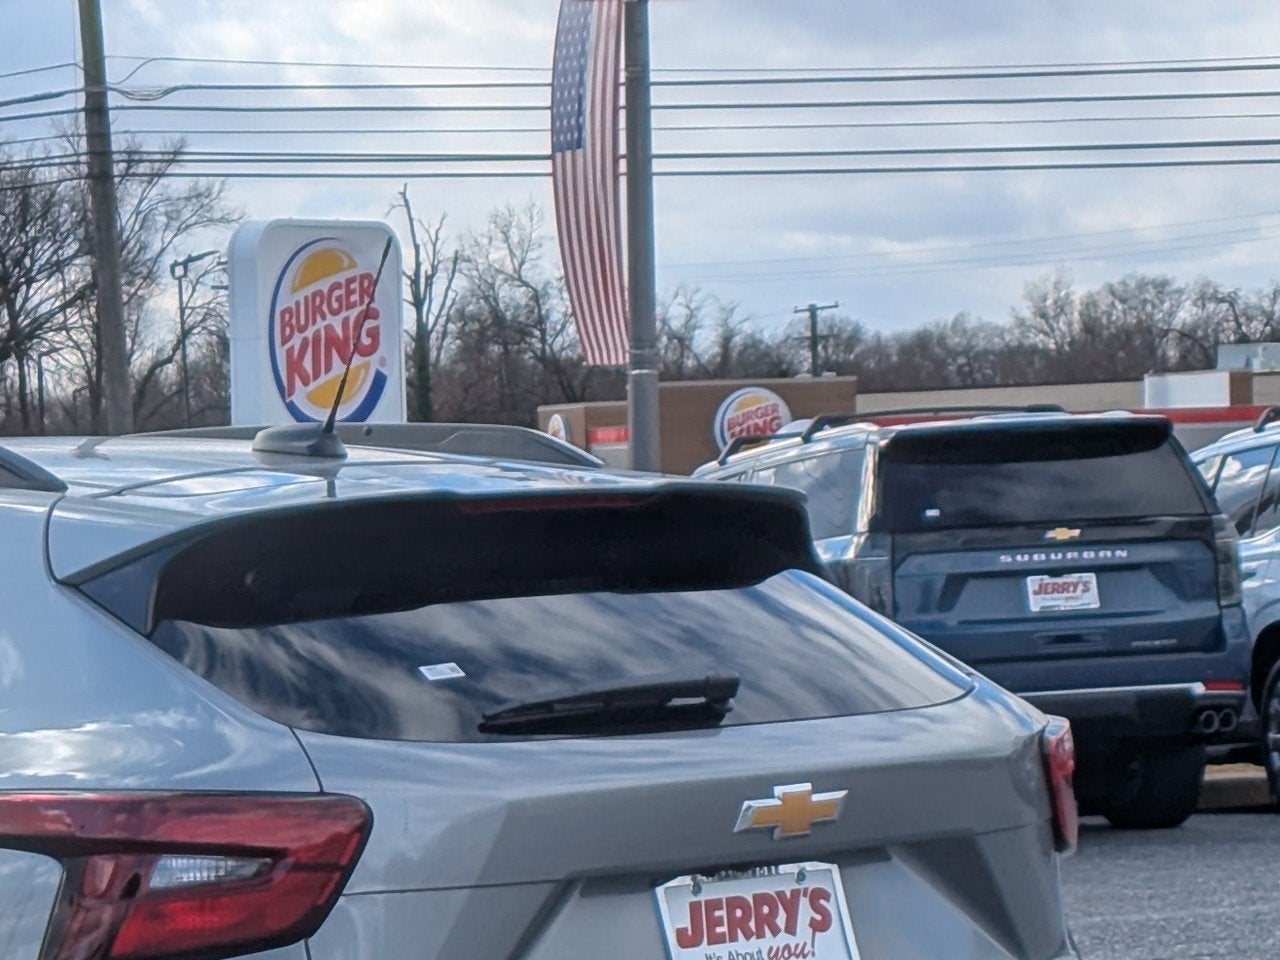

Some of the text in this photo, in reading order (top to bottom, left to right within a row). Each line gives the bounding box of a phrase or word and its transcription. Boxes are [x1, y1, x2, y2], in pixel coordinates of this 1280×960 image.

[279, 272, 376, 347] BURGER
[285, 306, 381, 400] KING
[727, 403, 780, 431] BURGER
[1033, 580, 1091, 596] JERRY'S
[675, 886, 833, 949] JERRY'S
